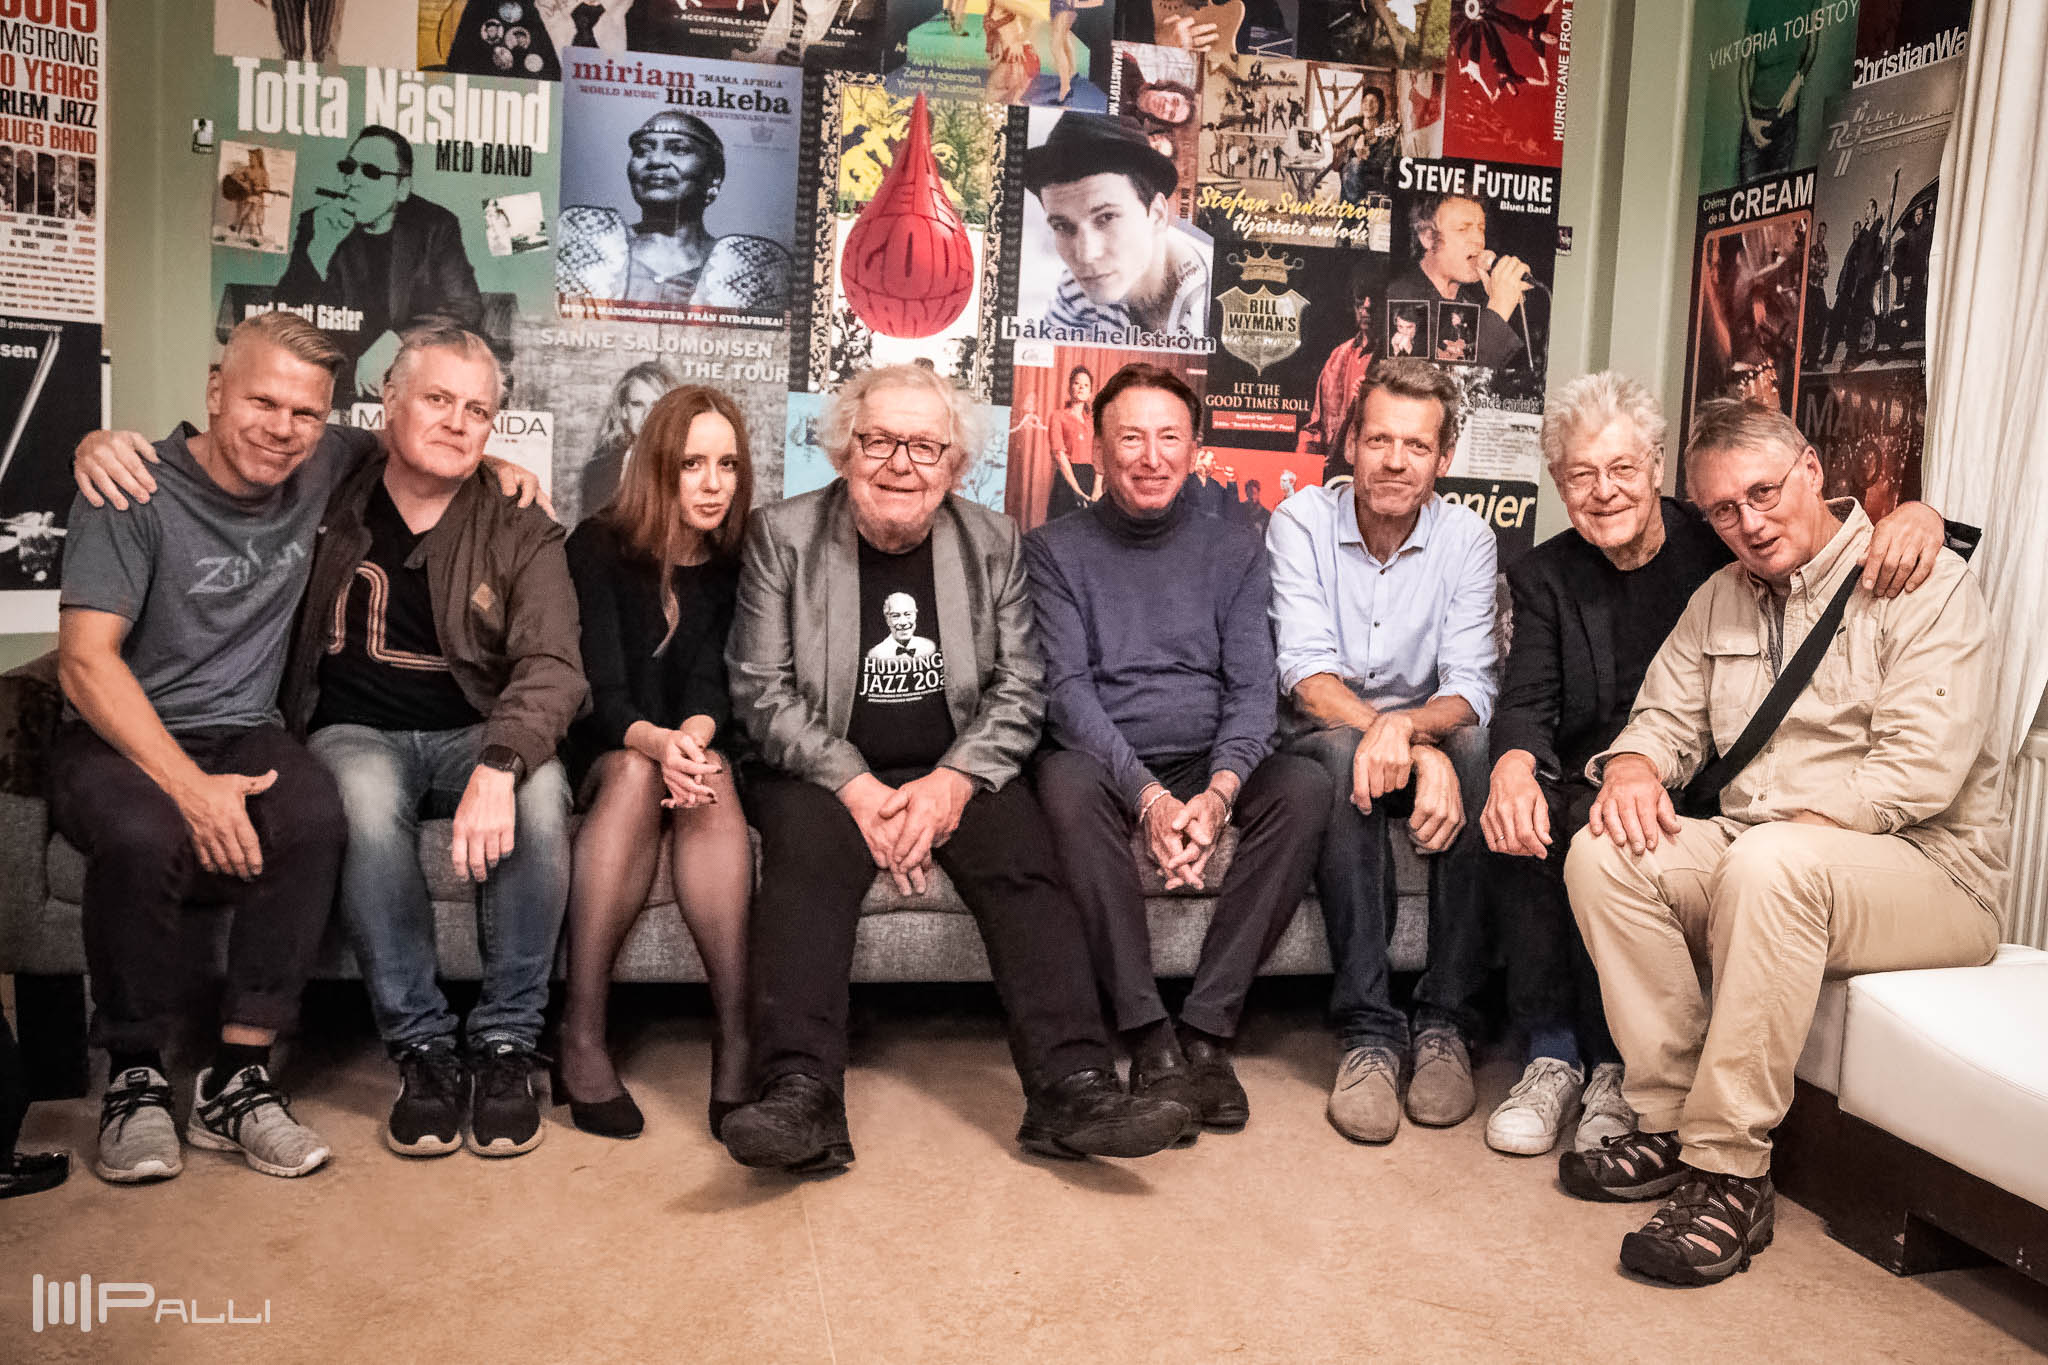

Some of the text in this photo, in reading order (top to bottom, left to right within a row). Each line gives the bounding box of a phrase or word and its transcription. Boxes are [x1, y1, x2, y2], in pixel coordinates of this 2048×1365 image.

[830, 28, 855, 36] TOUR
[1710, 0, 1858, 69] VIKTORIA TOLSTOY
[24, 57, 98, 101] YEARS
[572, 59, 695, 88] miriam
[1553, 9, 1572, 141] HURRICANE FROM
[54, 99, 97, 128] JAZZ
[233, 56, 550, 153] Totta Näslund
[664, 87, 792, 114] makeba
[50, 125, 97, 154] BAND
[436, 139, 533, 177] MED BAND
[1398, 156, 1553, 203] STEVE FUTURE
[1197, 186, 1270, 218] Stefan
[1275, 192, 1384, 220] Sundström
[1500, 200, 1551, 215] Blues Band
[1729, 173, 1815, 223] CREAM
[1233, 213, 1370, 242] Hjärtats melodi
[317, 304, 364, 331] Gäster
[688, 310, 717, 321] FRÅN
[719, 314, 784, 327] SYDAFRIKA!
[1250, 299, 1278, 314] BILL
[1003, 317, 1085, 342] håkan
[1094, 325, 1216, 352] hellström
[1229, 313, 1297, 332] WYMAN'S
[541, 329, 773, 359] SANNE SALOMONSEN
[683, 360, 790, 383] THE TOUR
[1205, 394, 1311, 411] GOOD TIMES ROLL
[1234, 382, 1280, 396] LET THE
[860, 673, 909, 696] JAZZ
